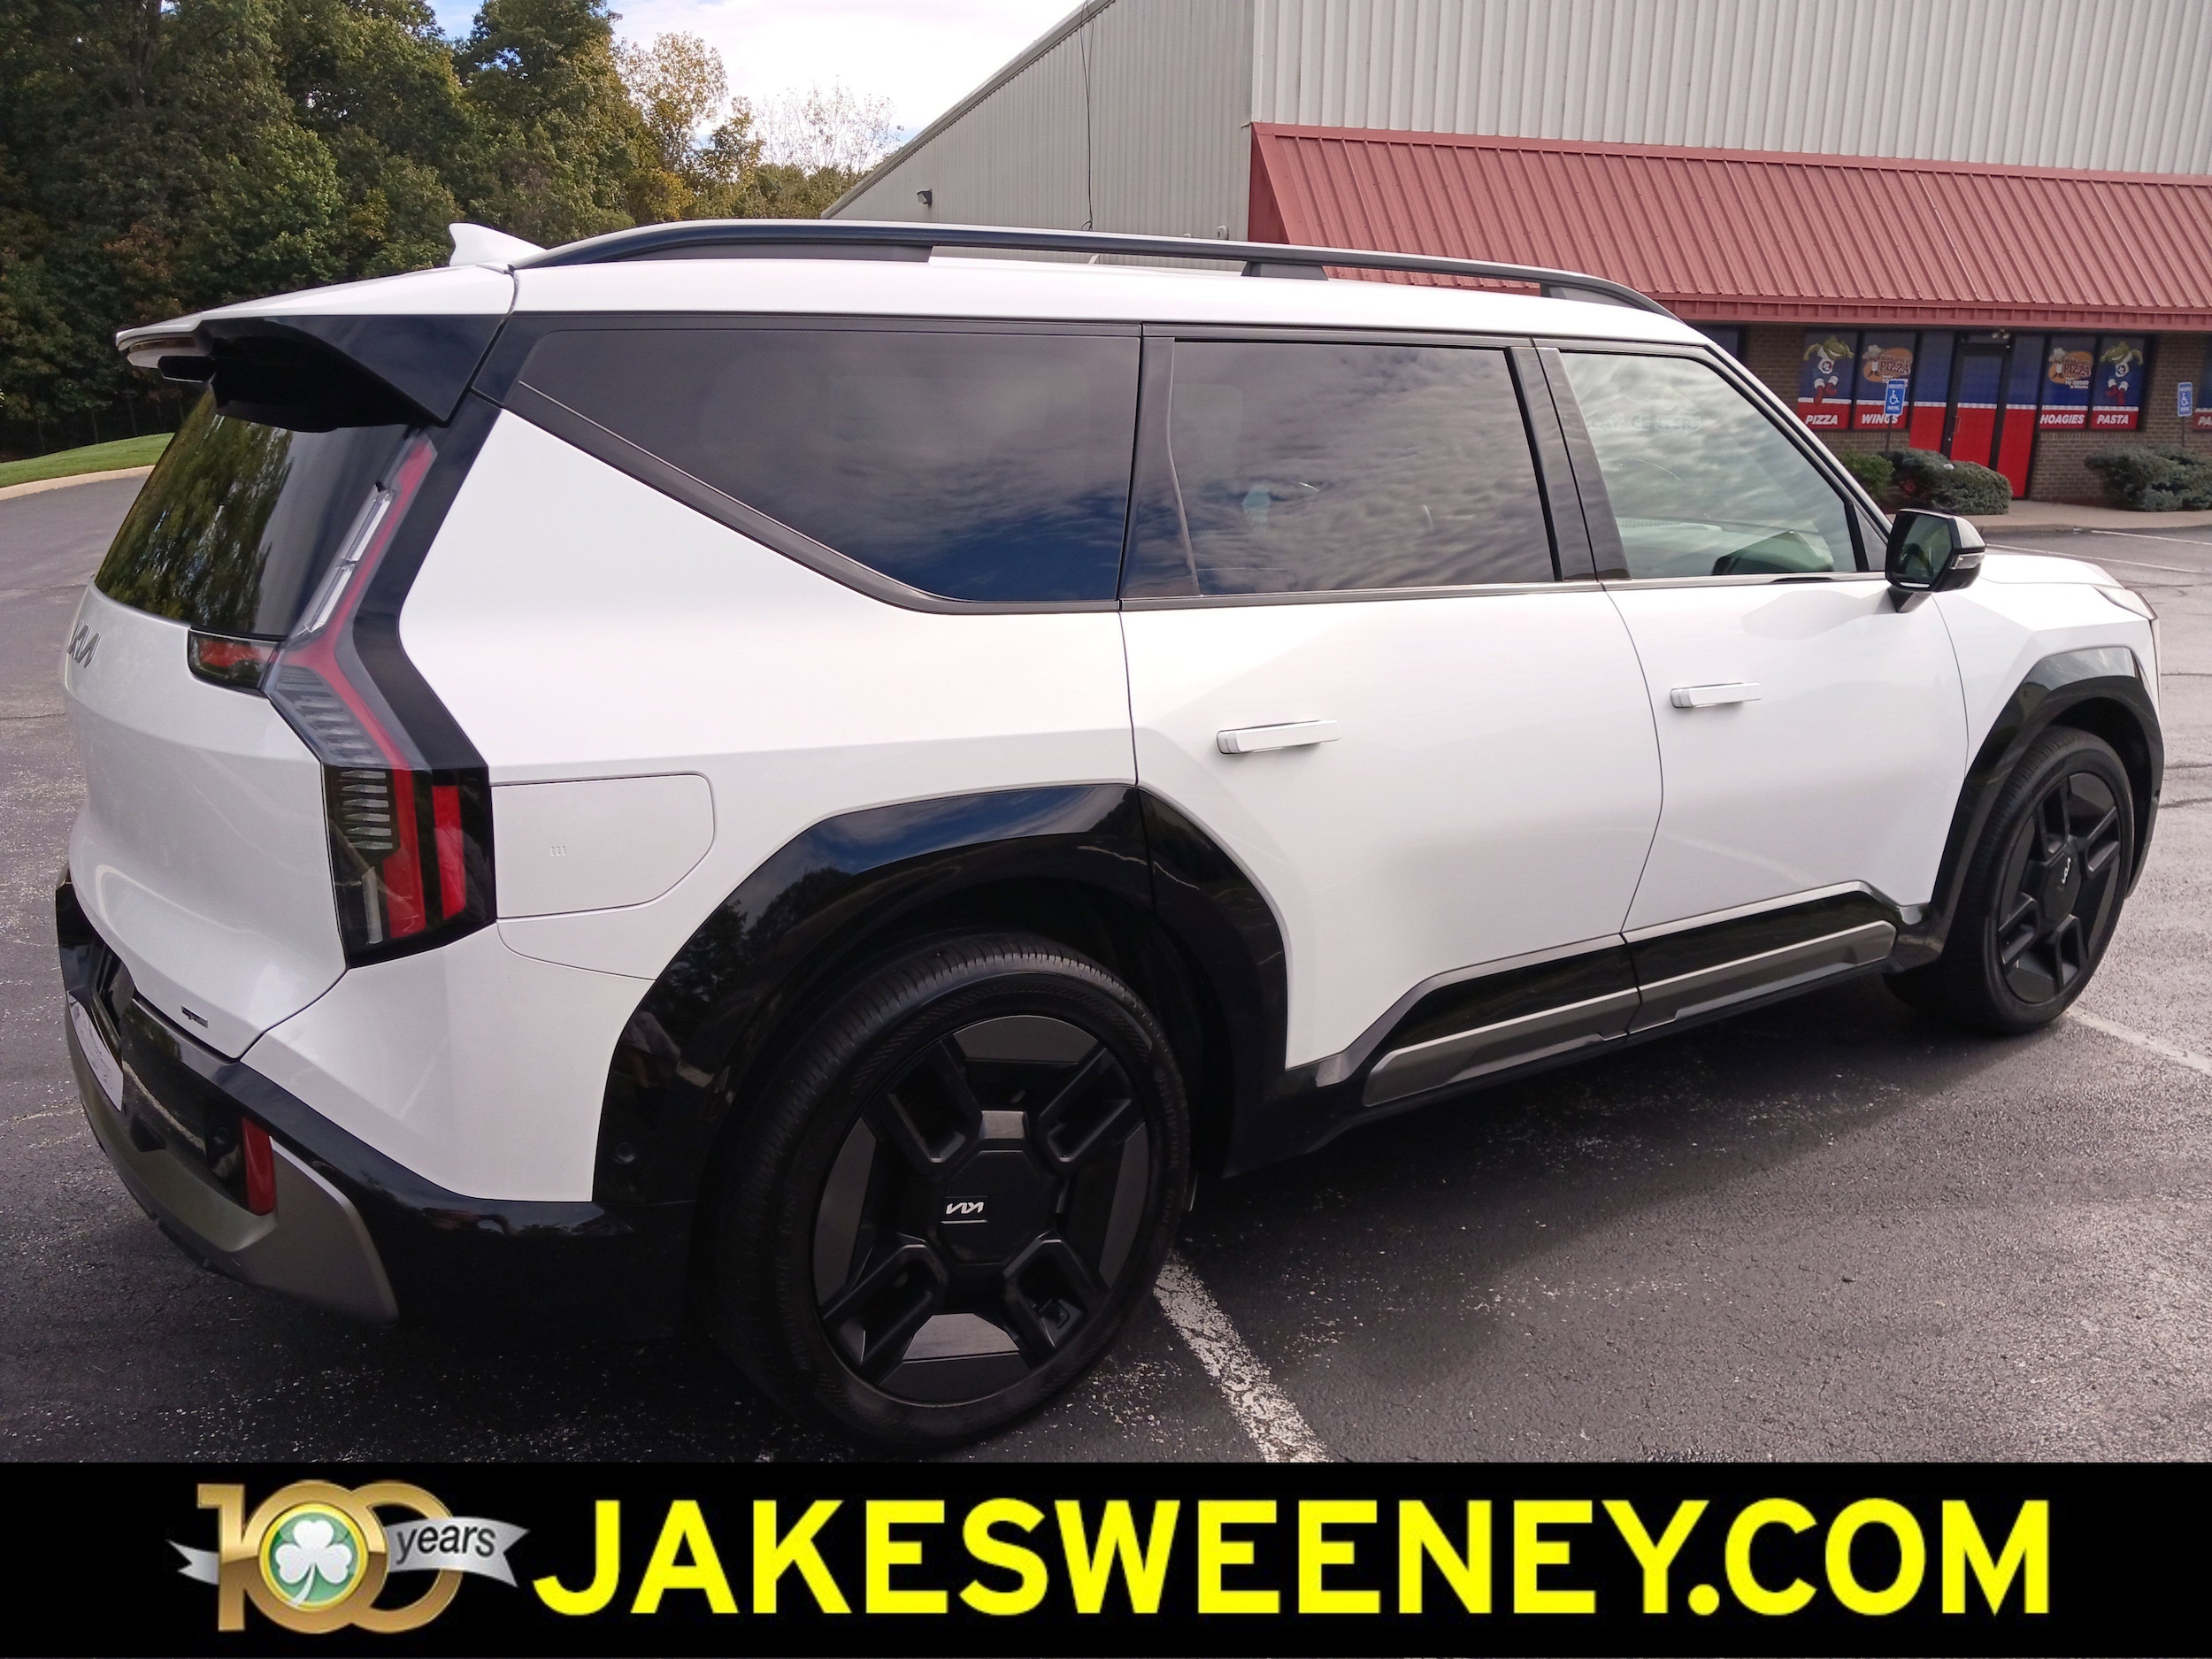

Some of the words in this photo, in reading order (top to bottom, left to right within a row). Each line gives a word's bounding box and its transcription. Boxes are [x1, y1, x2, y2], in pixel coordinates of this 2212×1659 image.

[1805, 414, 1839, 425] PIZZA
[1862, 414, 1899, 425] WINGS
[2039, 414, 2085, 425] HOAGIES
[2096, 414, 2129, 425] PASTA
[2198, 416, 2212, 426] PA
